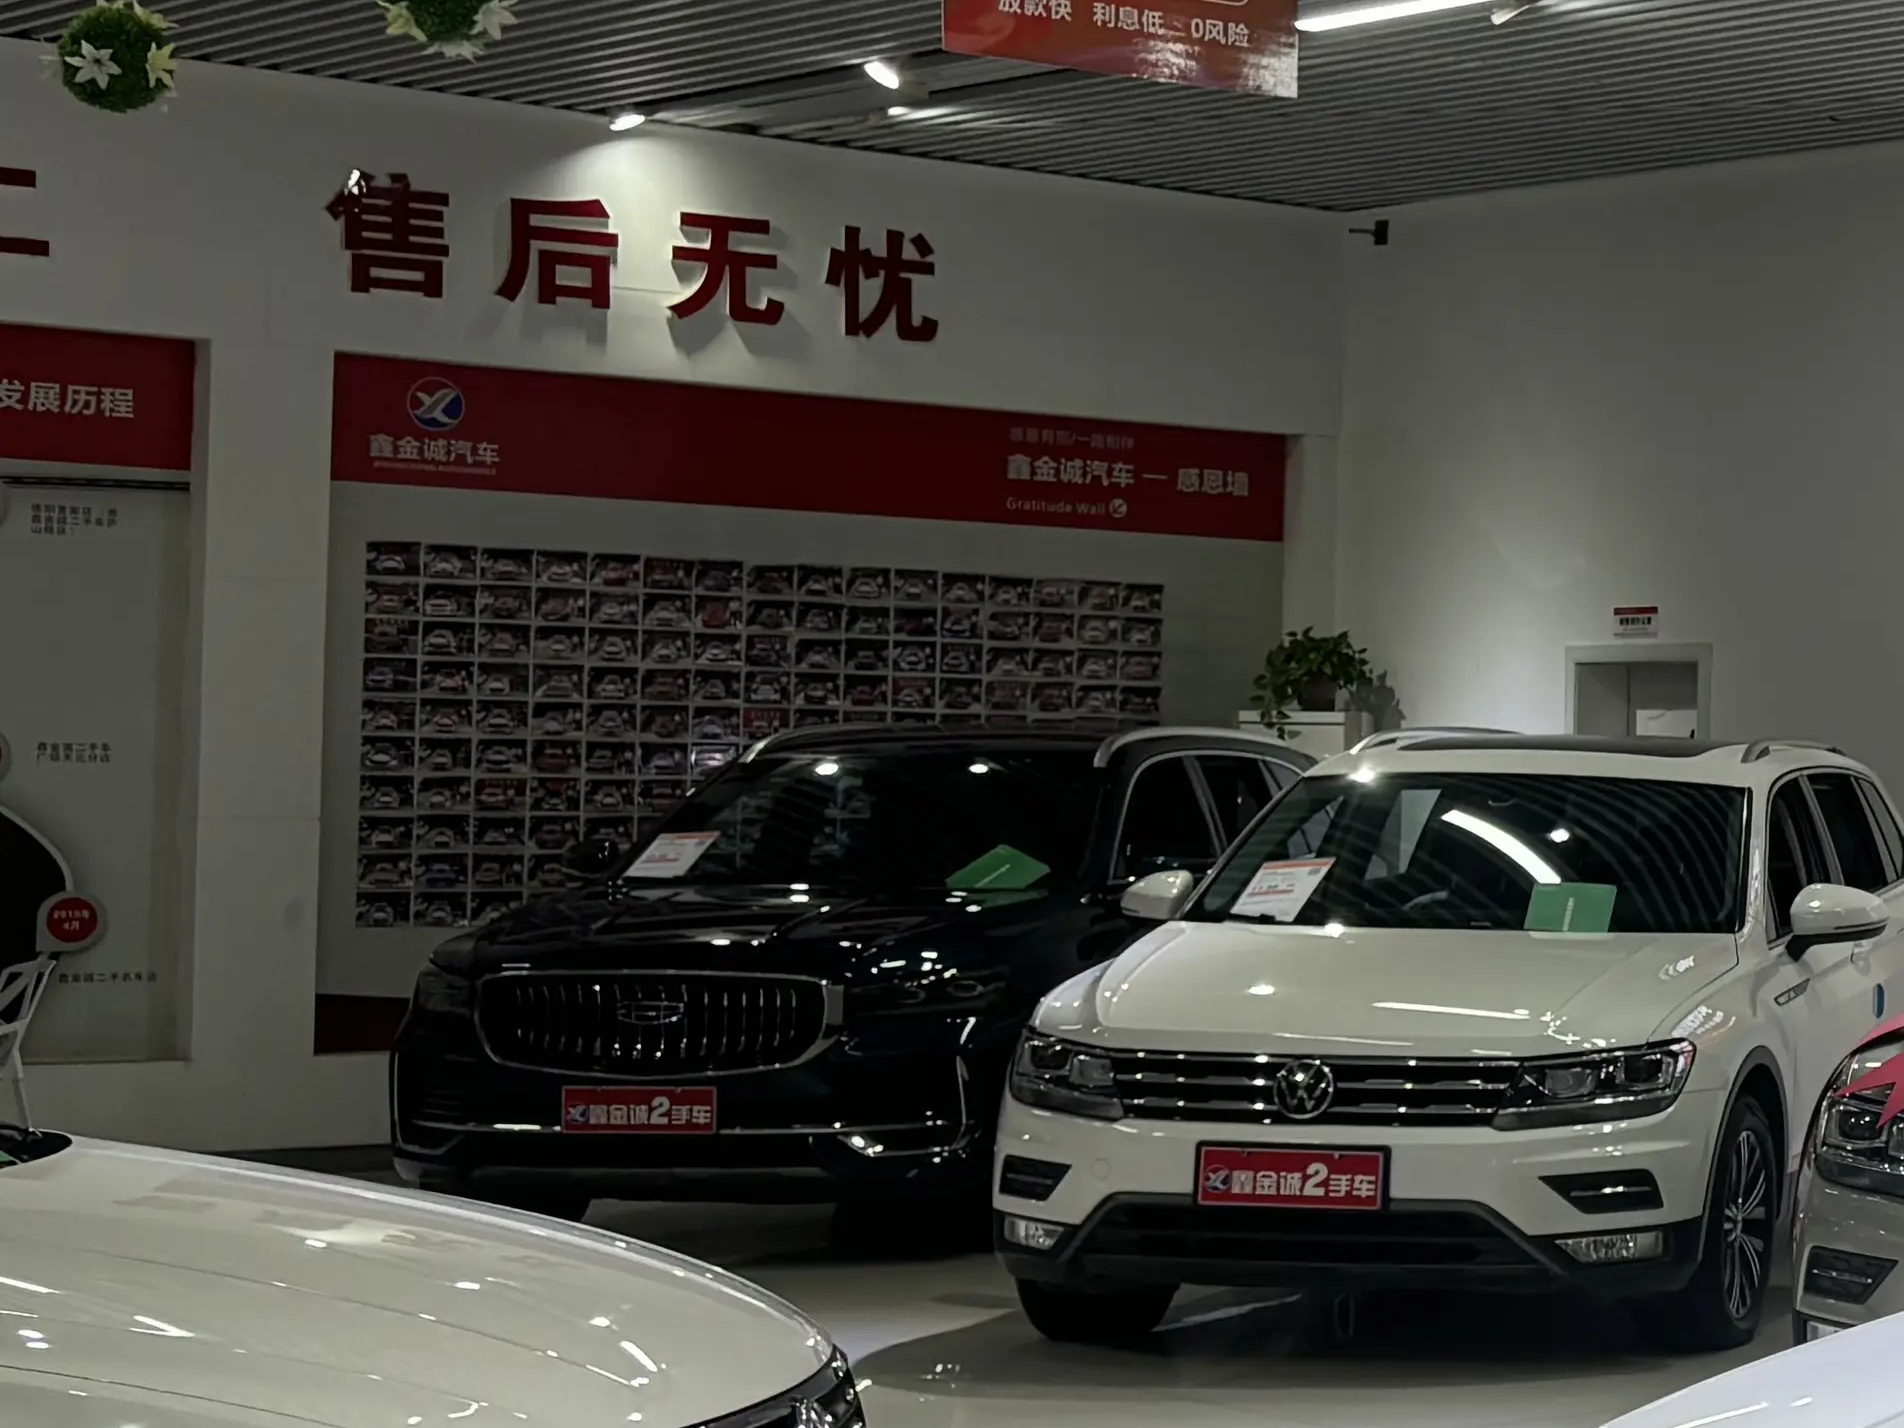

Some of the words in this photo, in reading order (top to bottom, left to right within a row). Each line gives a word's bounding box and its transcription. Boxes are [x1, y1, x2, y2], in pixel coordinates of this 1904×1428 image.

[1093, 2, 1164, 35] 利息低
[1191, 18, 1250, 47] 0风险
[325, 169, 939, 342] 售后无忧
[0, 378, 135, 419] 发展历程
[368, 432, 500, 466] 鑫金诚汽车
[1006, 497, 1073, 514] Gratitude
[1076, 500, 1106, 516] Wall
[1230, 1162, 1377, 1198] 鑫金诚2手车
